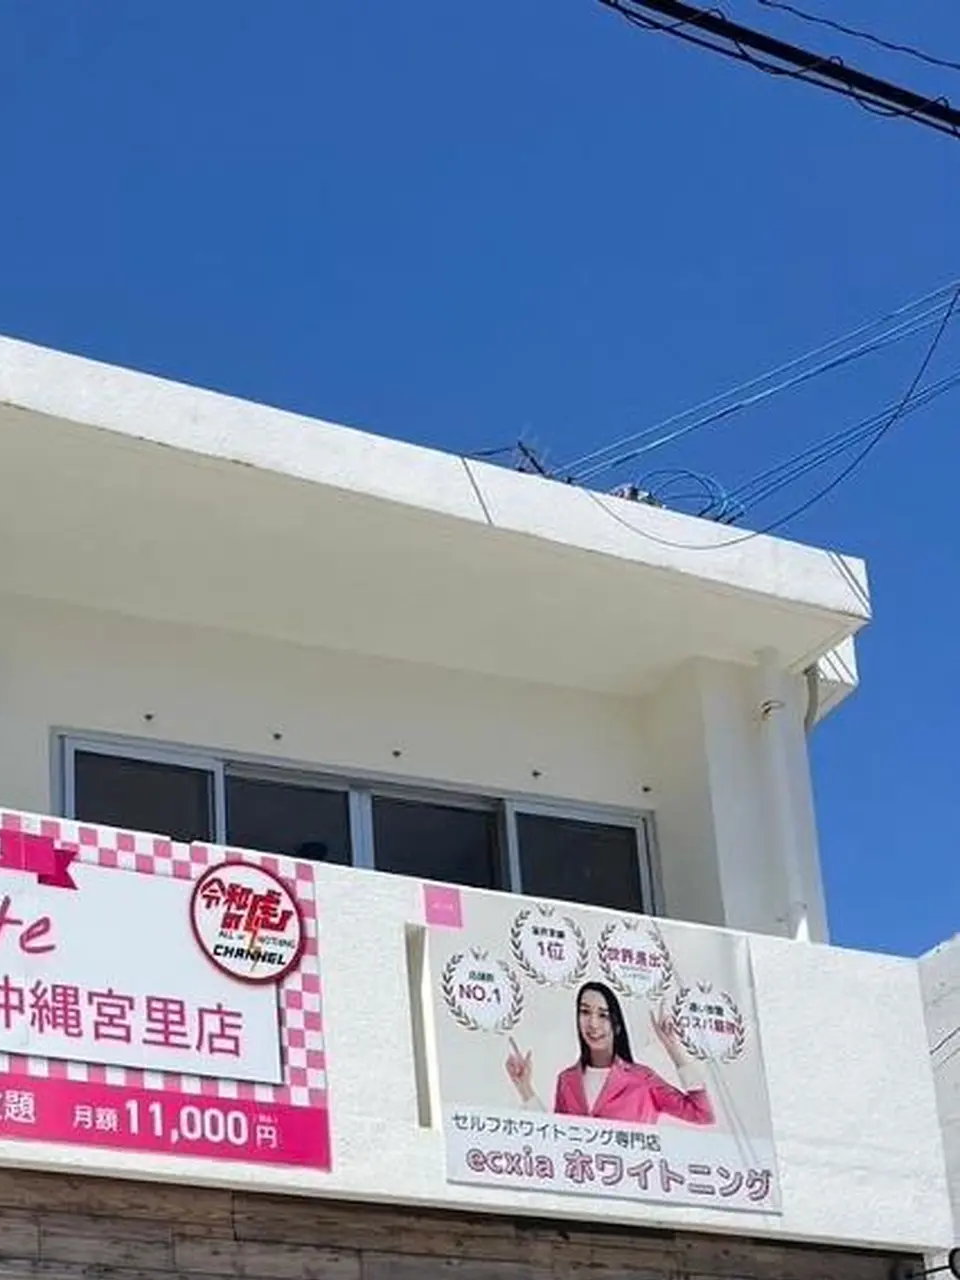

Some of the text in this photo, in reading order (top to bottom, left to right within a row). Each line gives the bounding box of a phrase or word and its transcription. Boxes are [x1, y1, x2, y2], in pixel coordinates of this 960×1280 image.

[213, 943, 287, 966] CHANNEL
[537, 940, 566, 961] 1位
[458, 984, 502, 1004] NO.1
[72, 1098, 279, 1150] 月額 11,000 円
[451, 1112, 662, 1152] セルフホワイトニング専門店
[465, 1144, 774, 1203] ecxia ホワイトニング
